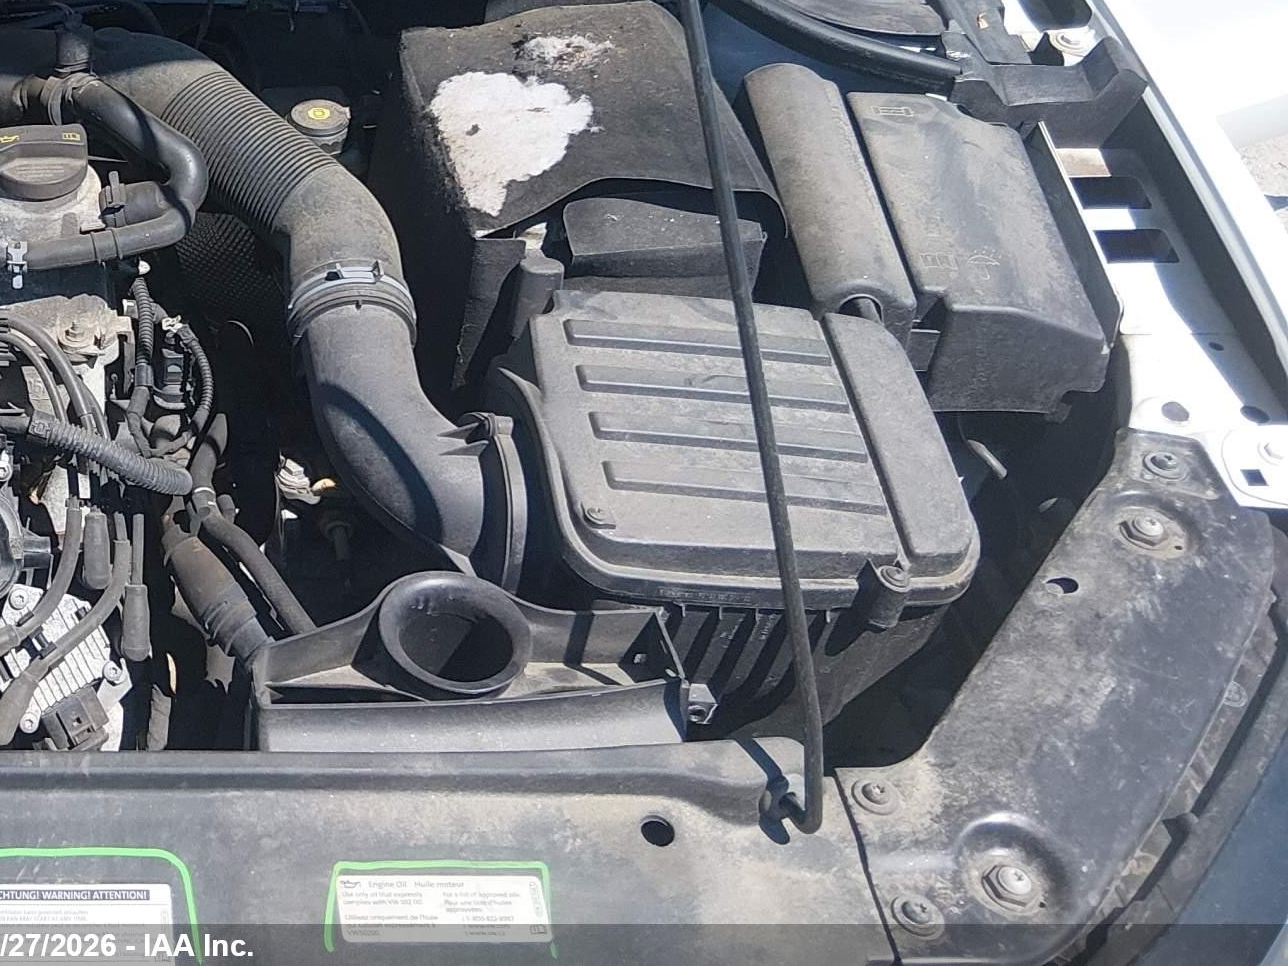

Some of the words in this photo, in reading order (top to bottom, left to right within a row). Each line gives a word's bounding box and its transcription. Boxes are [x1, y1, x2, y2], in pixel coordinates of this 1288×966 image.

[368, 881, 394, 890] Engine
[42, 890, 91, 900] WARNING!
[92, 890, 147, 900] ATTENTION!
